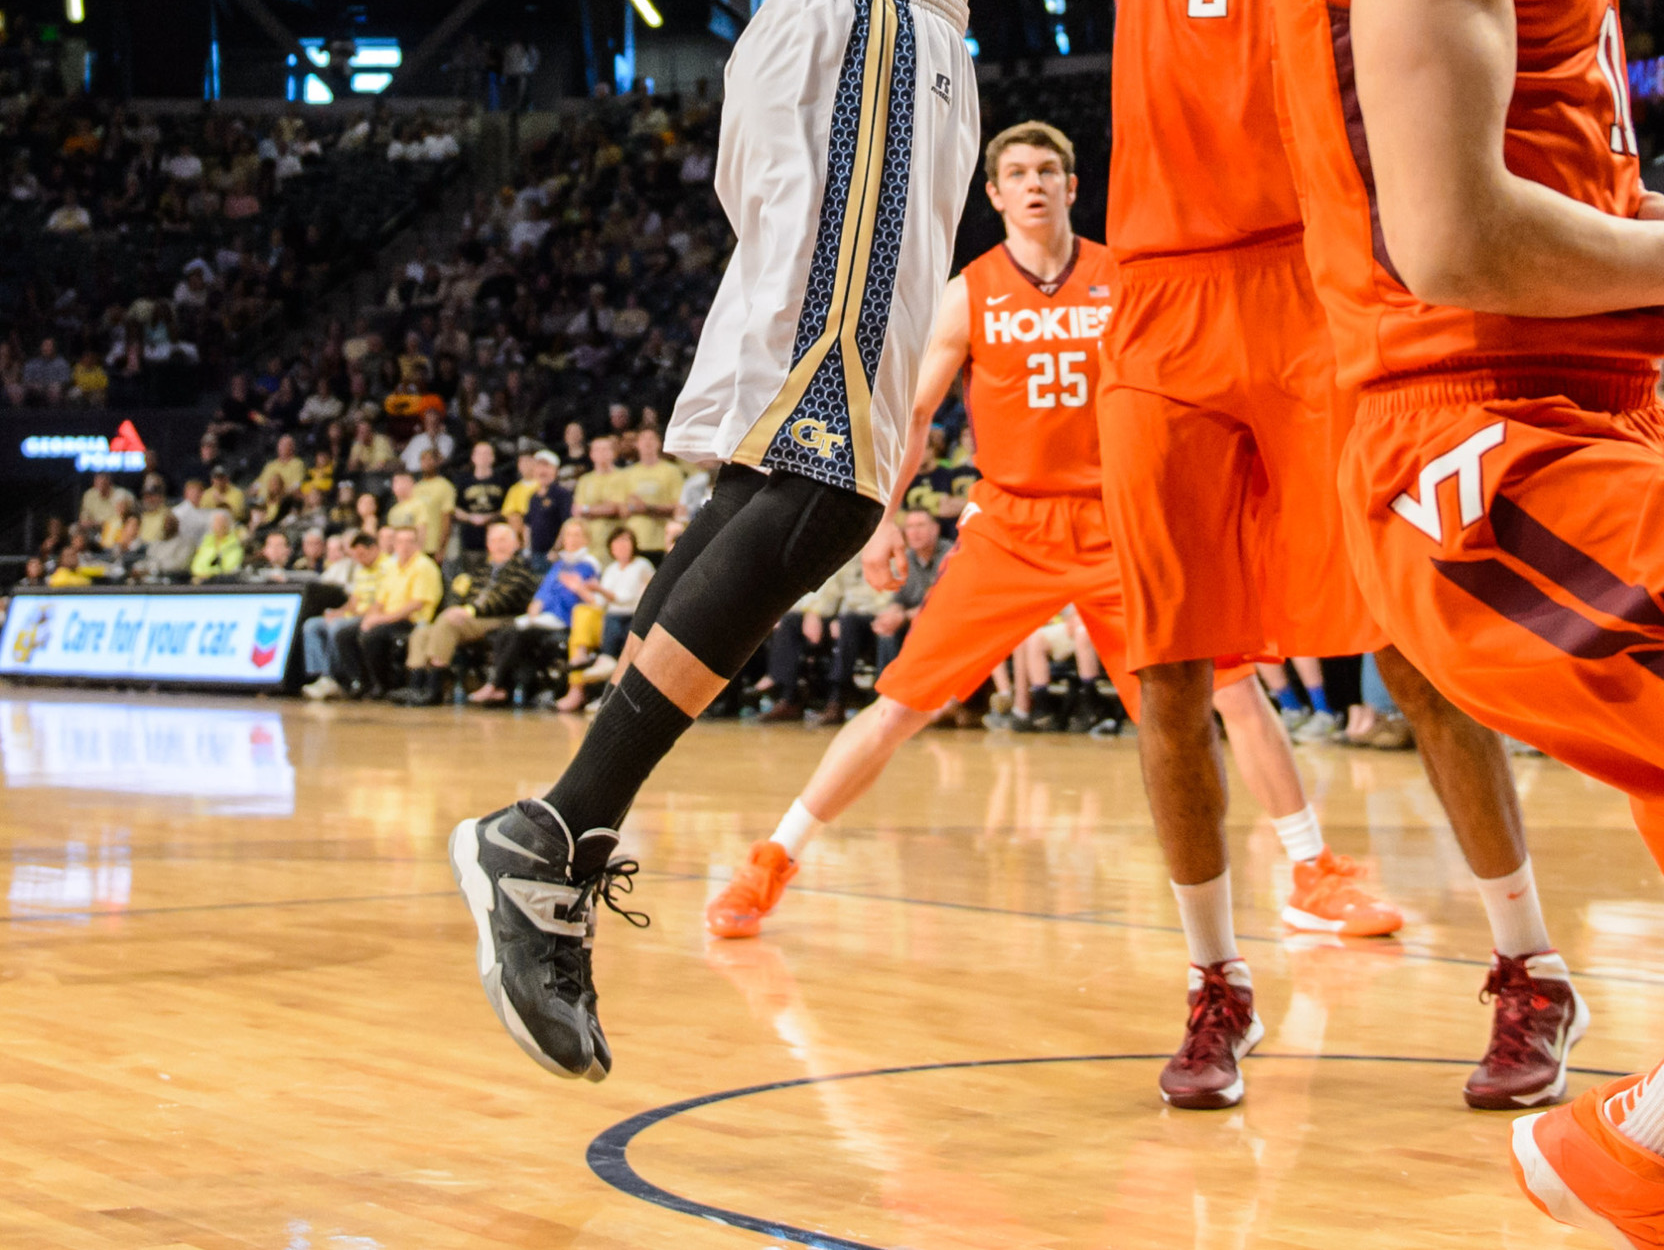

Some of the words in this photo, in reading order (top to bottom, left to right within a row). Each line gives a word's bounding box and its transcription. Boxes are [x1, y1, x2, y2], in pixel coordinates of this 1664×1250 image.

[1027, 351, 1088, 408] 25
[791, 418, 845, 458] GT
[1388, 418, 1507, 546] VT
